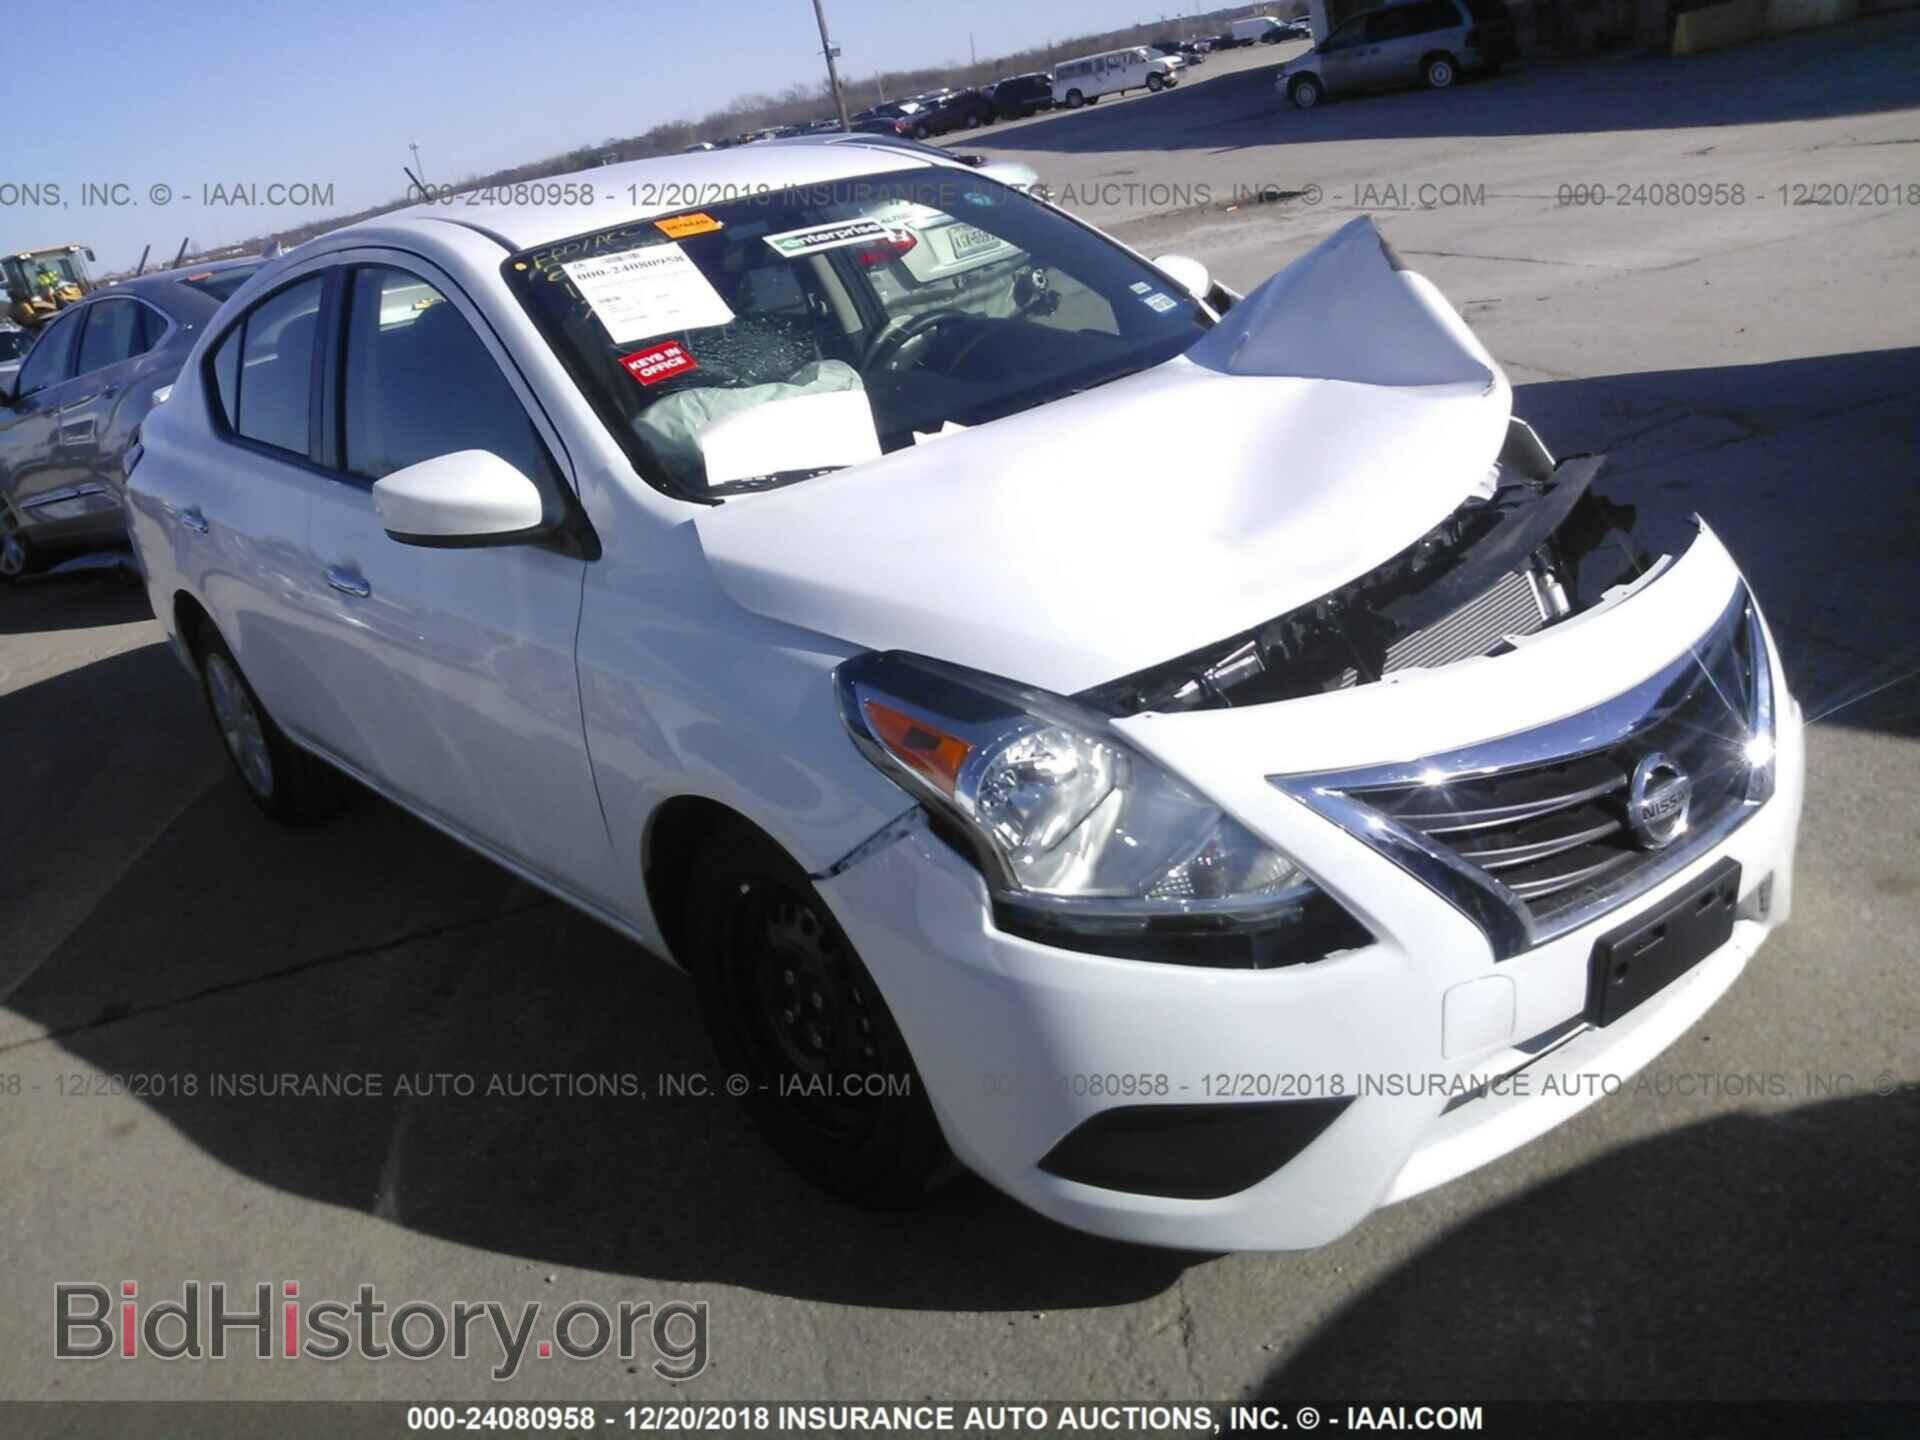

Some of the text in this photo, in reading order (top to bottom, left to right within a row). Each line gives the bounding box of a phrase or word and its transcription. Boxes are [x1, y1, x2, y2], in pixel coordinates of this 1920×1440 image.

[782, 223, 881, 248] enterprise
[627, 346, 682, 371] KEYS IN
[640, 356, 687, 377] OFFICE
[1643, 788, 1688, 820] NISSA
